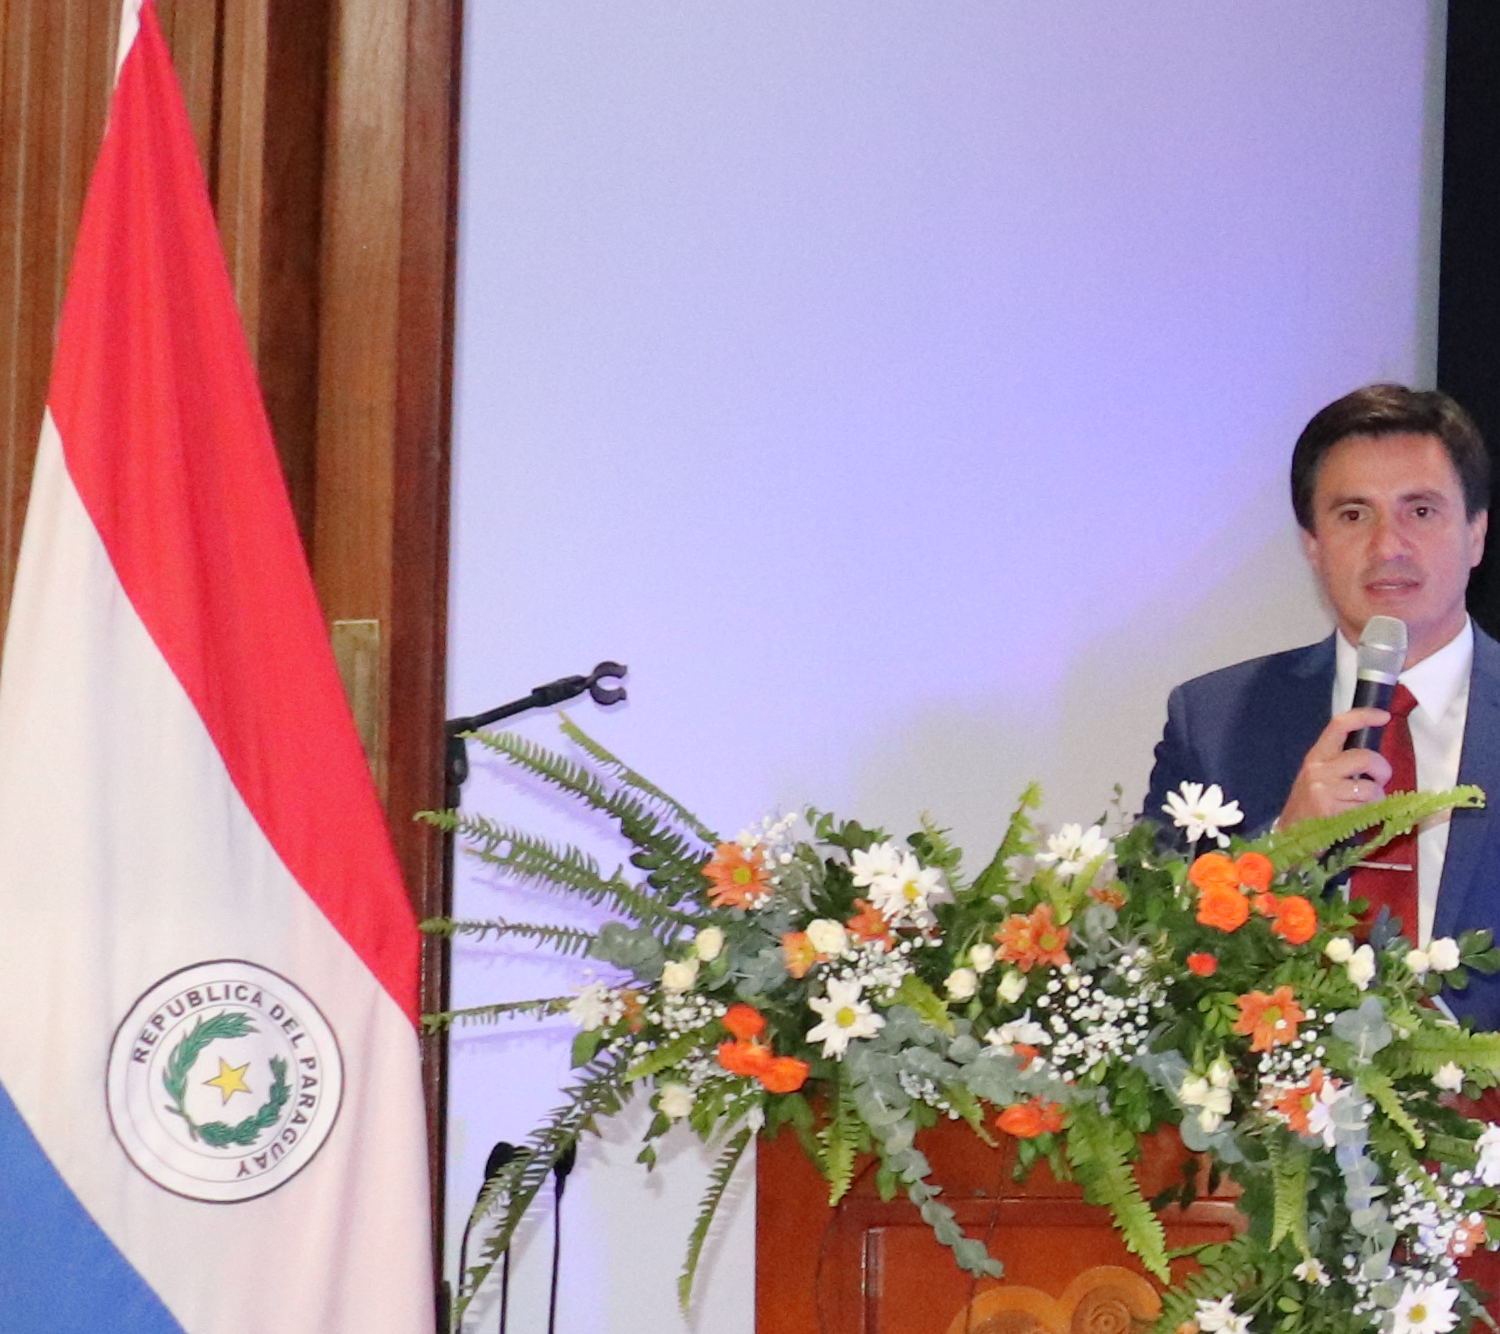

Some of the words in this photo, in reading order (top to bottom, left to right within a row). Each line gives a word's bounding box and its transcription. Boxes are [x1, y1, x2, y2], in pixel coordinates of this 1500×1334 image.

[132, 983, 262, 1064] REPUBLICA
[269, 1004, 307, 1049] DEL
[236, 1056, 318, 1178] PARAGUAY
